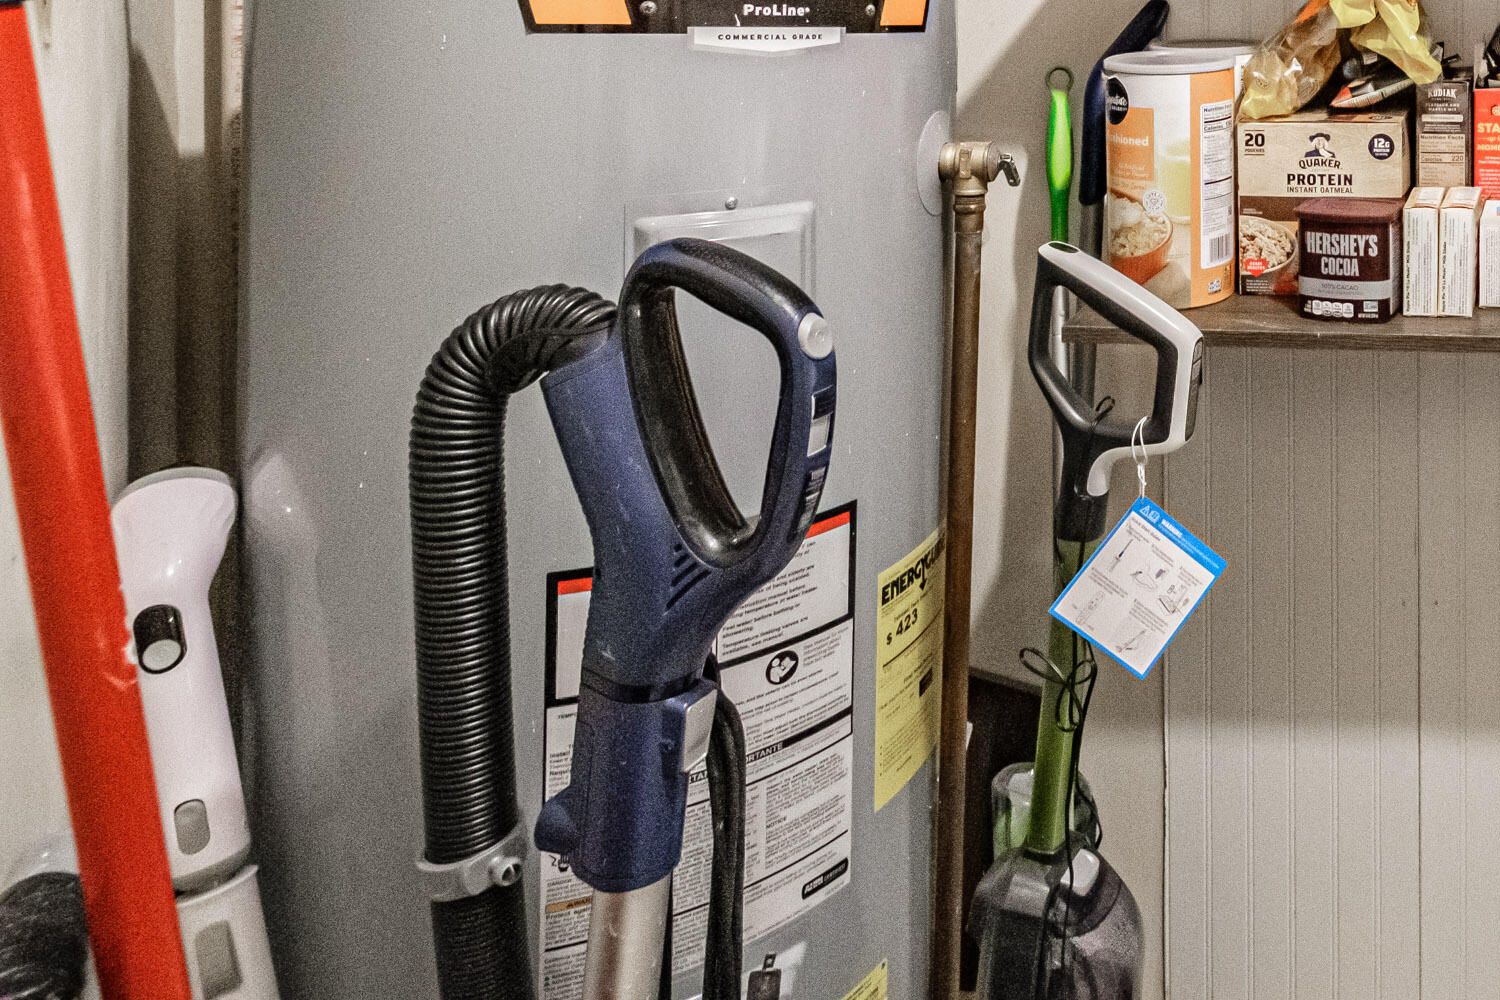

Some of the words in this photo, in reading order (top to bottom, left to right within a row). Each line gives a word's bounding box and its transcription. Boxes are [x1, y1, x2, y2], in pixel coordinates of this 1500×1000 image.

[743, 3, 805, 16] ProLine
[1428, 88, 1458, 99] KODIAK
[1244, 133, 1265, 147] 20
[1299, 159, 1341, 170] QUAKER
[1287, 173, 1353, 186] PROTEIN
[1320, 186, 1353, 194] OATMEAL
[1306, 231, 1379, 258] HERSHEY'S
[1320, 256, 1360, 277] COCOA
[896, 608, 918, 636] 423
